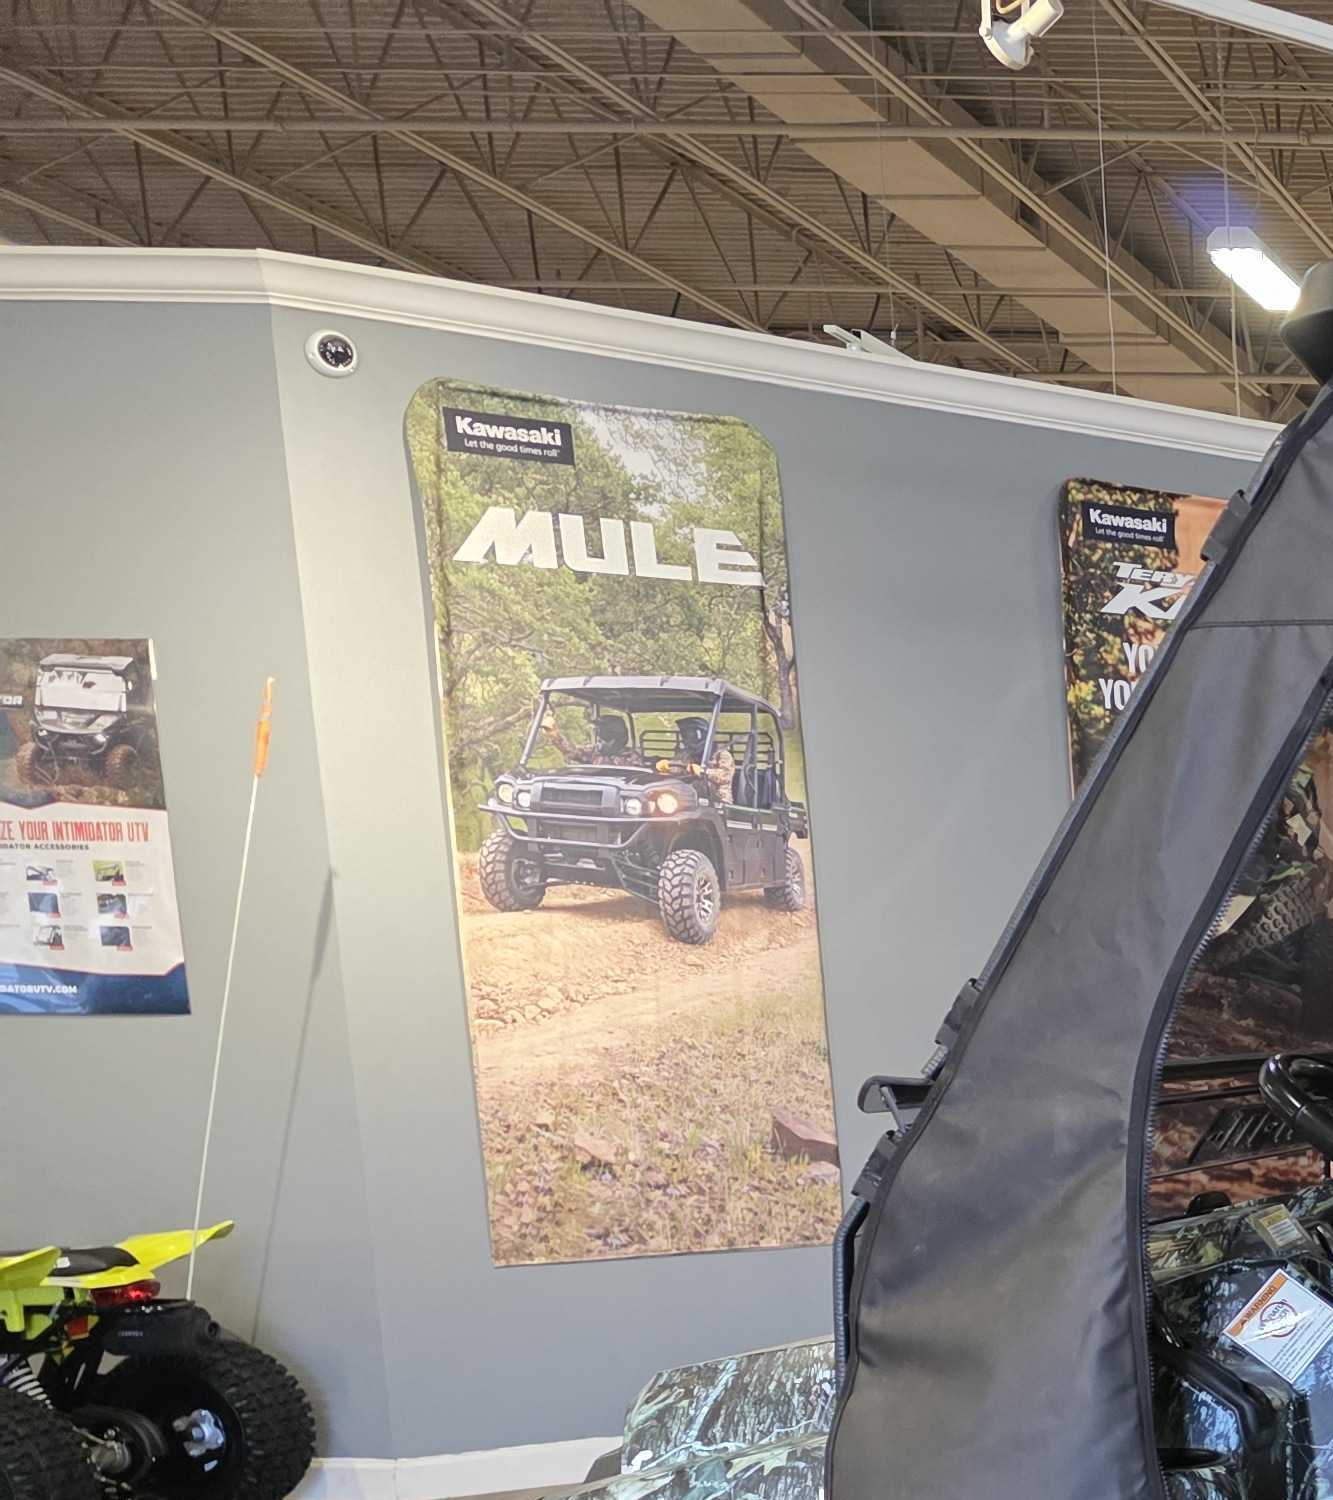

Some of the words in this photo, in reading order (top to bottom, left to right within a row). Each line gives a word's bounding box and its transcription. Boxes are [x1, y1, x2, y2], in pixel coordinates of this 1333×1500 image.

[455, 415, 562, 446] Kawasaki
[463, 437, 479, 448] Let
[479, 440, 494, 450] the
[496, 443, 518, 453] good
[519, 446, 542, 456] times
[1089, 508, 1167, 533] Kawasaki
[453, 506, 765, 587] MULE
[19, 820, 49, 841] YOUR
[52, 821, 123, 842] INTIMIDATOR
[127, 821, 150, 842] UTV
